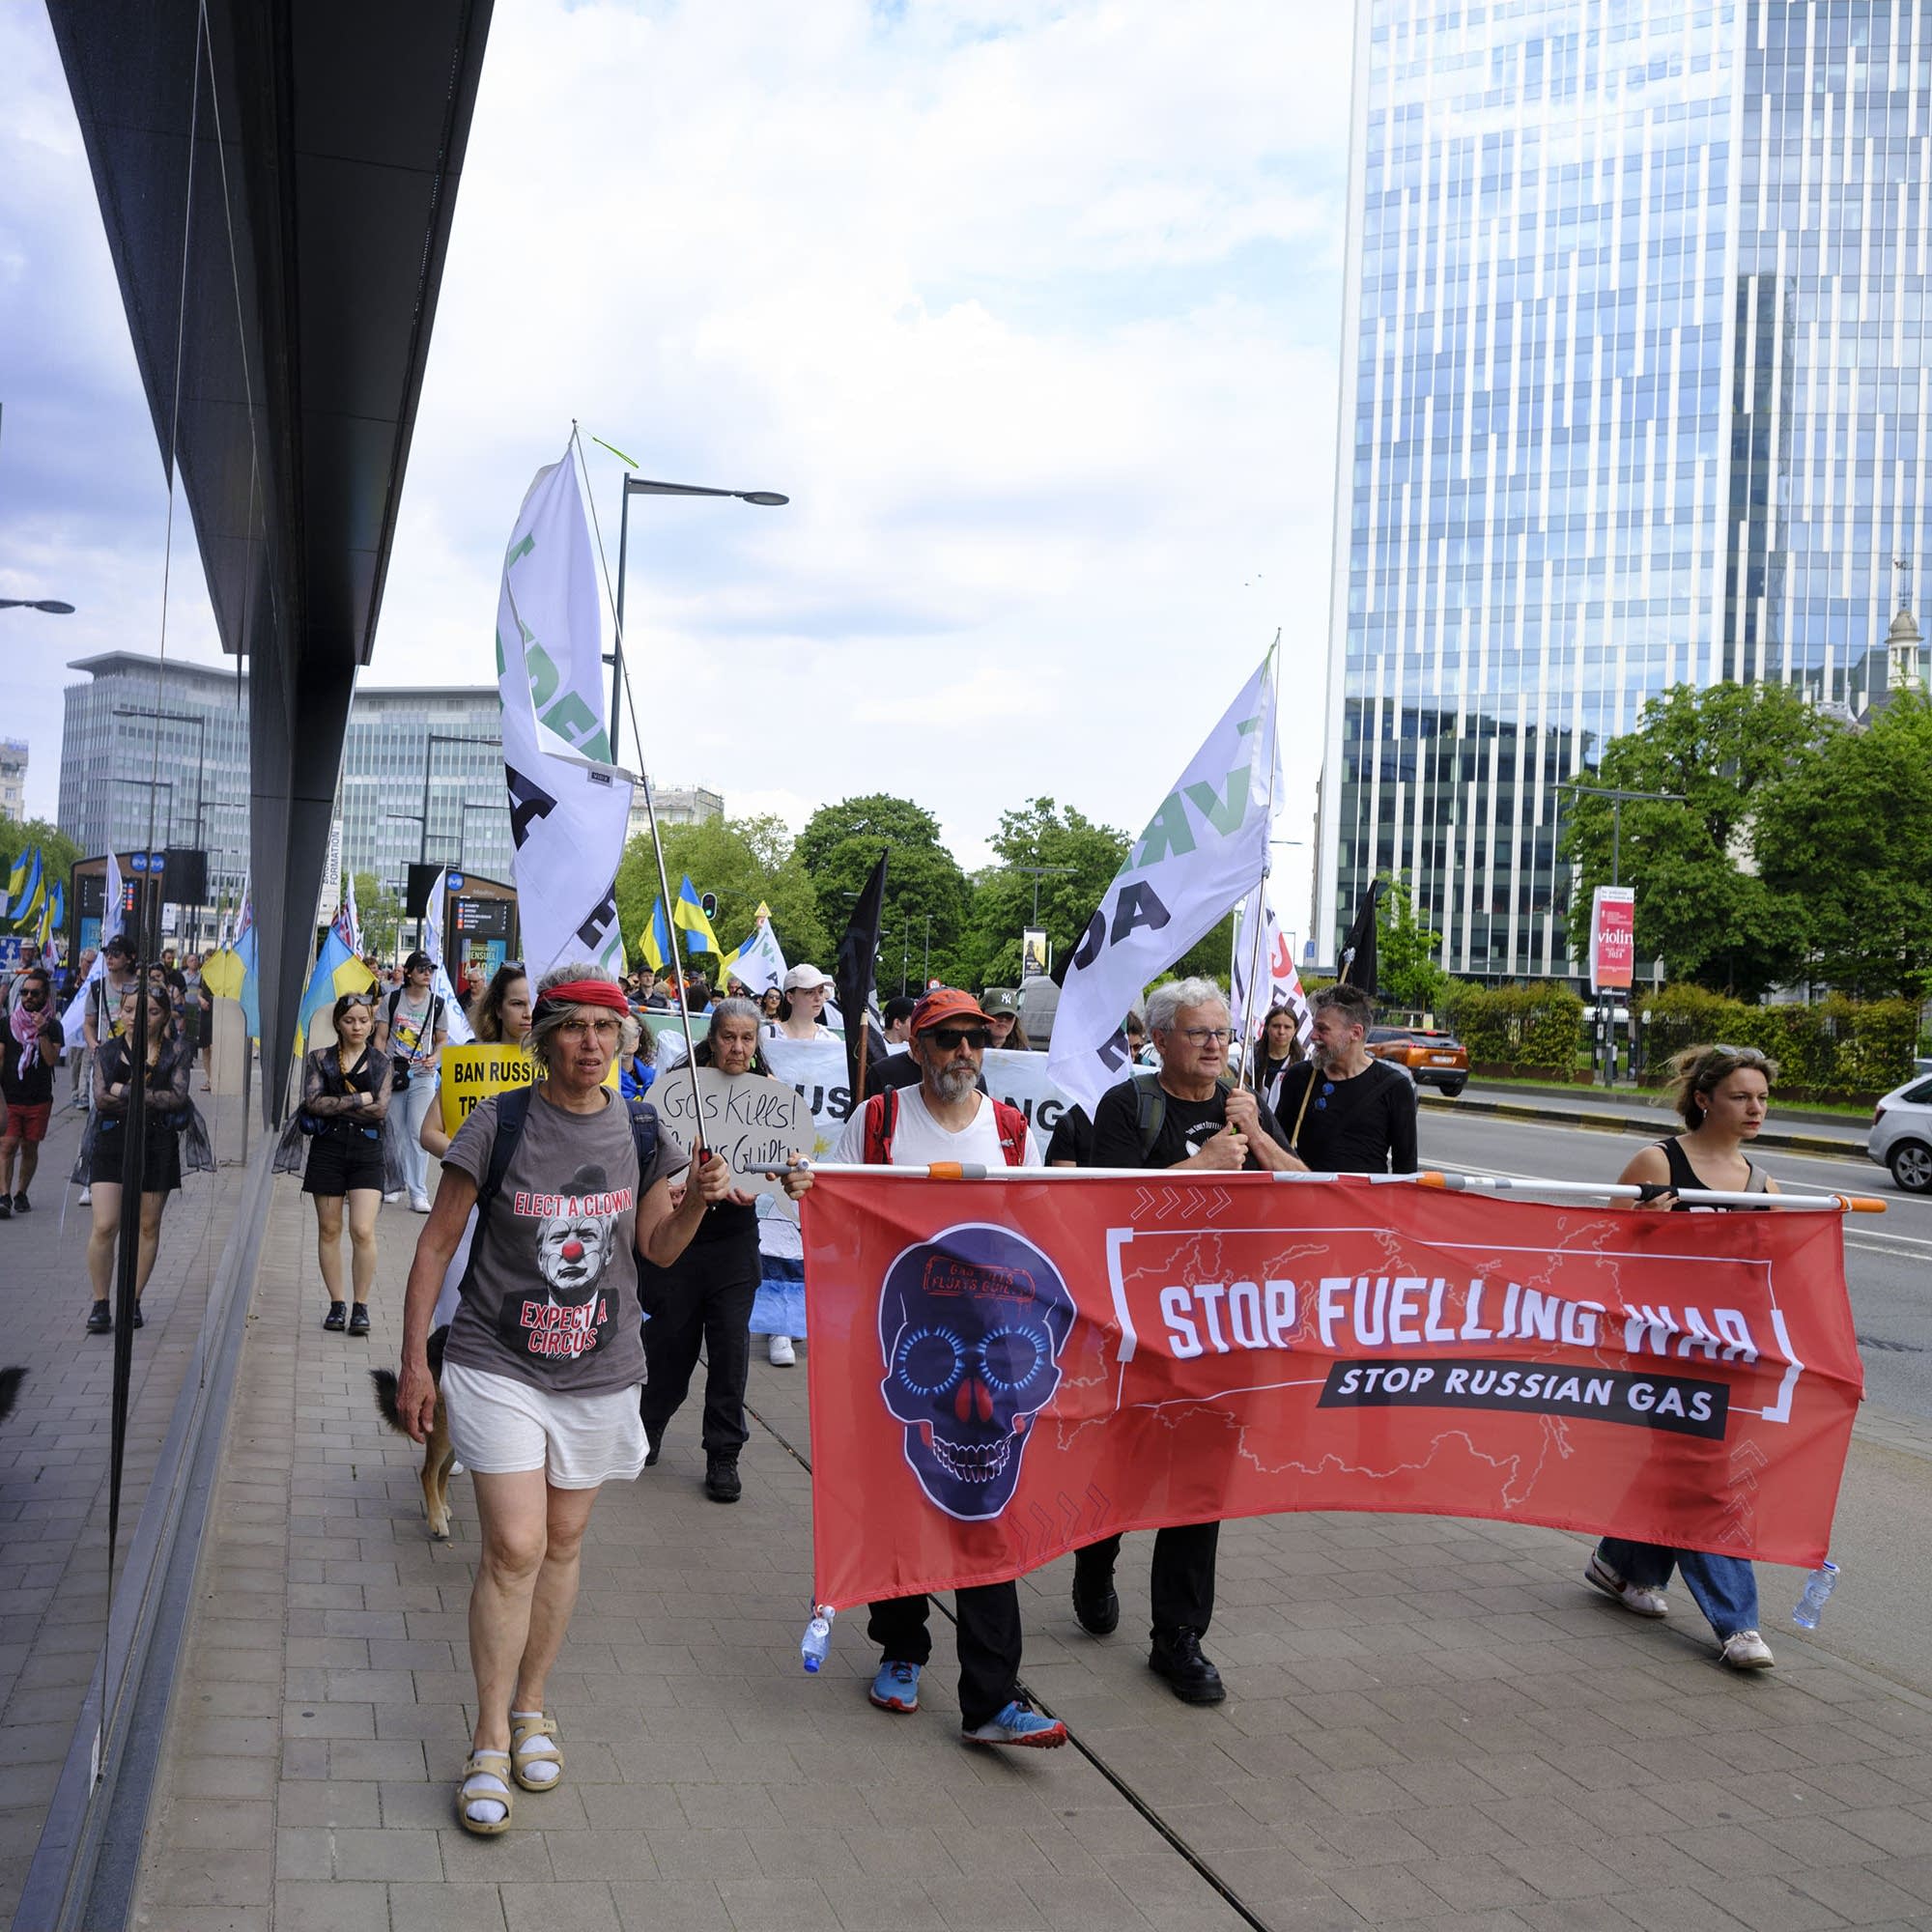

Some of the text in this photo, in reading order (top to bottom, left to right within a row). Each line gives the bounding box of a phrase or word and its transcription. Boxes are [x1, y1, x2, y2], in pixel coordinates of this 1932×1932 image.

[329, 831, 340, 886] FORMATION
[1598, 928, 1634, 945] violin
[454, 1062, 548, 1083] BAN RUSSIA
[725, 1084, 797, 1131] Kills!
[514, 1187, 633, 1217] ELECT A CLOWN
[520, 1298, 609, 1331] EXPECT A
[1160, 1276, 1758, 1363] STOP FUELLING WAR
[527, 1328, 597, 1354] CIRCUS
[1338, 1367, 1713, 1422] STOP RUSSIAN GAS
